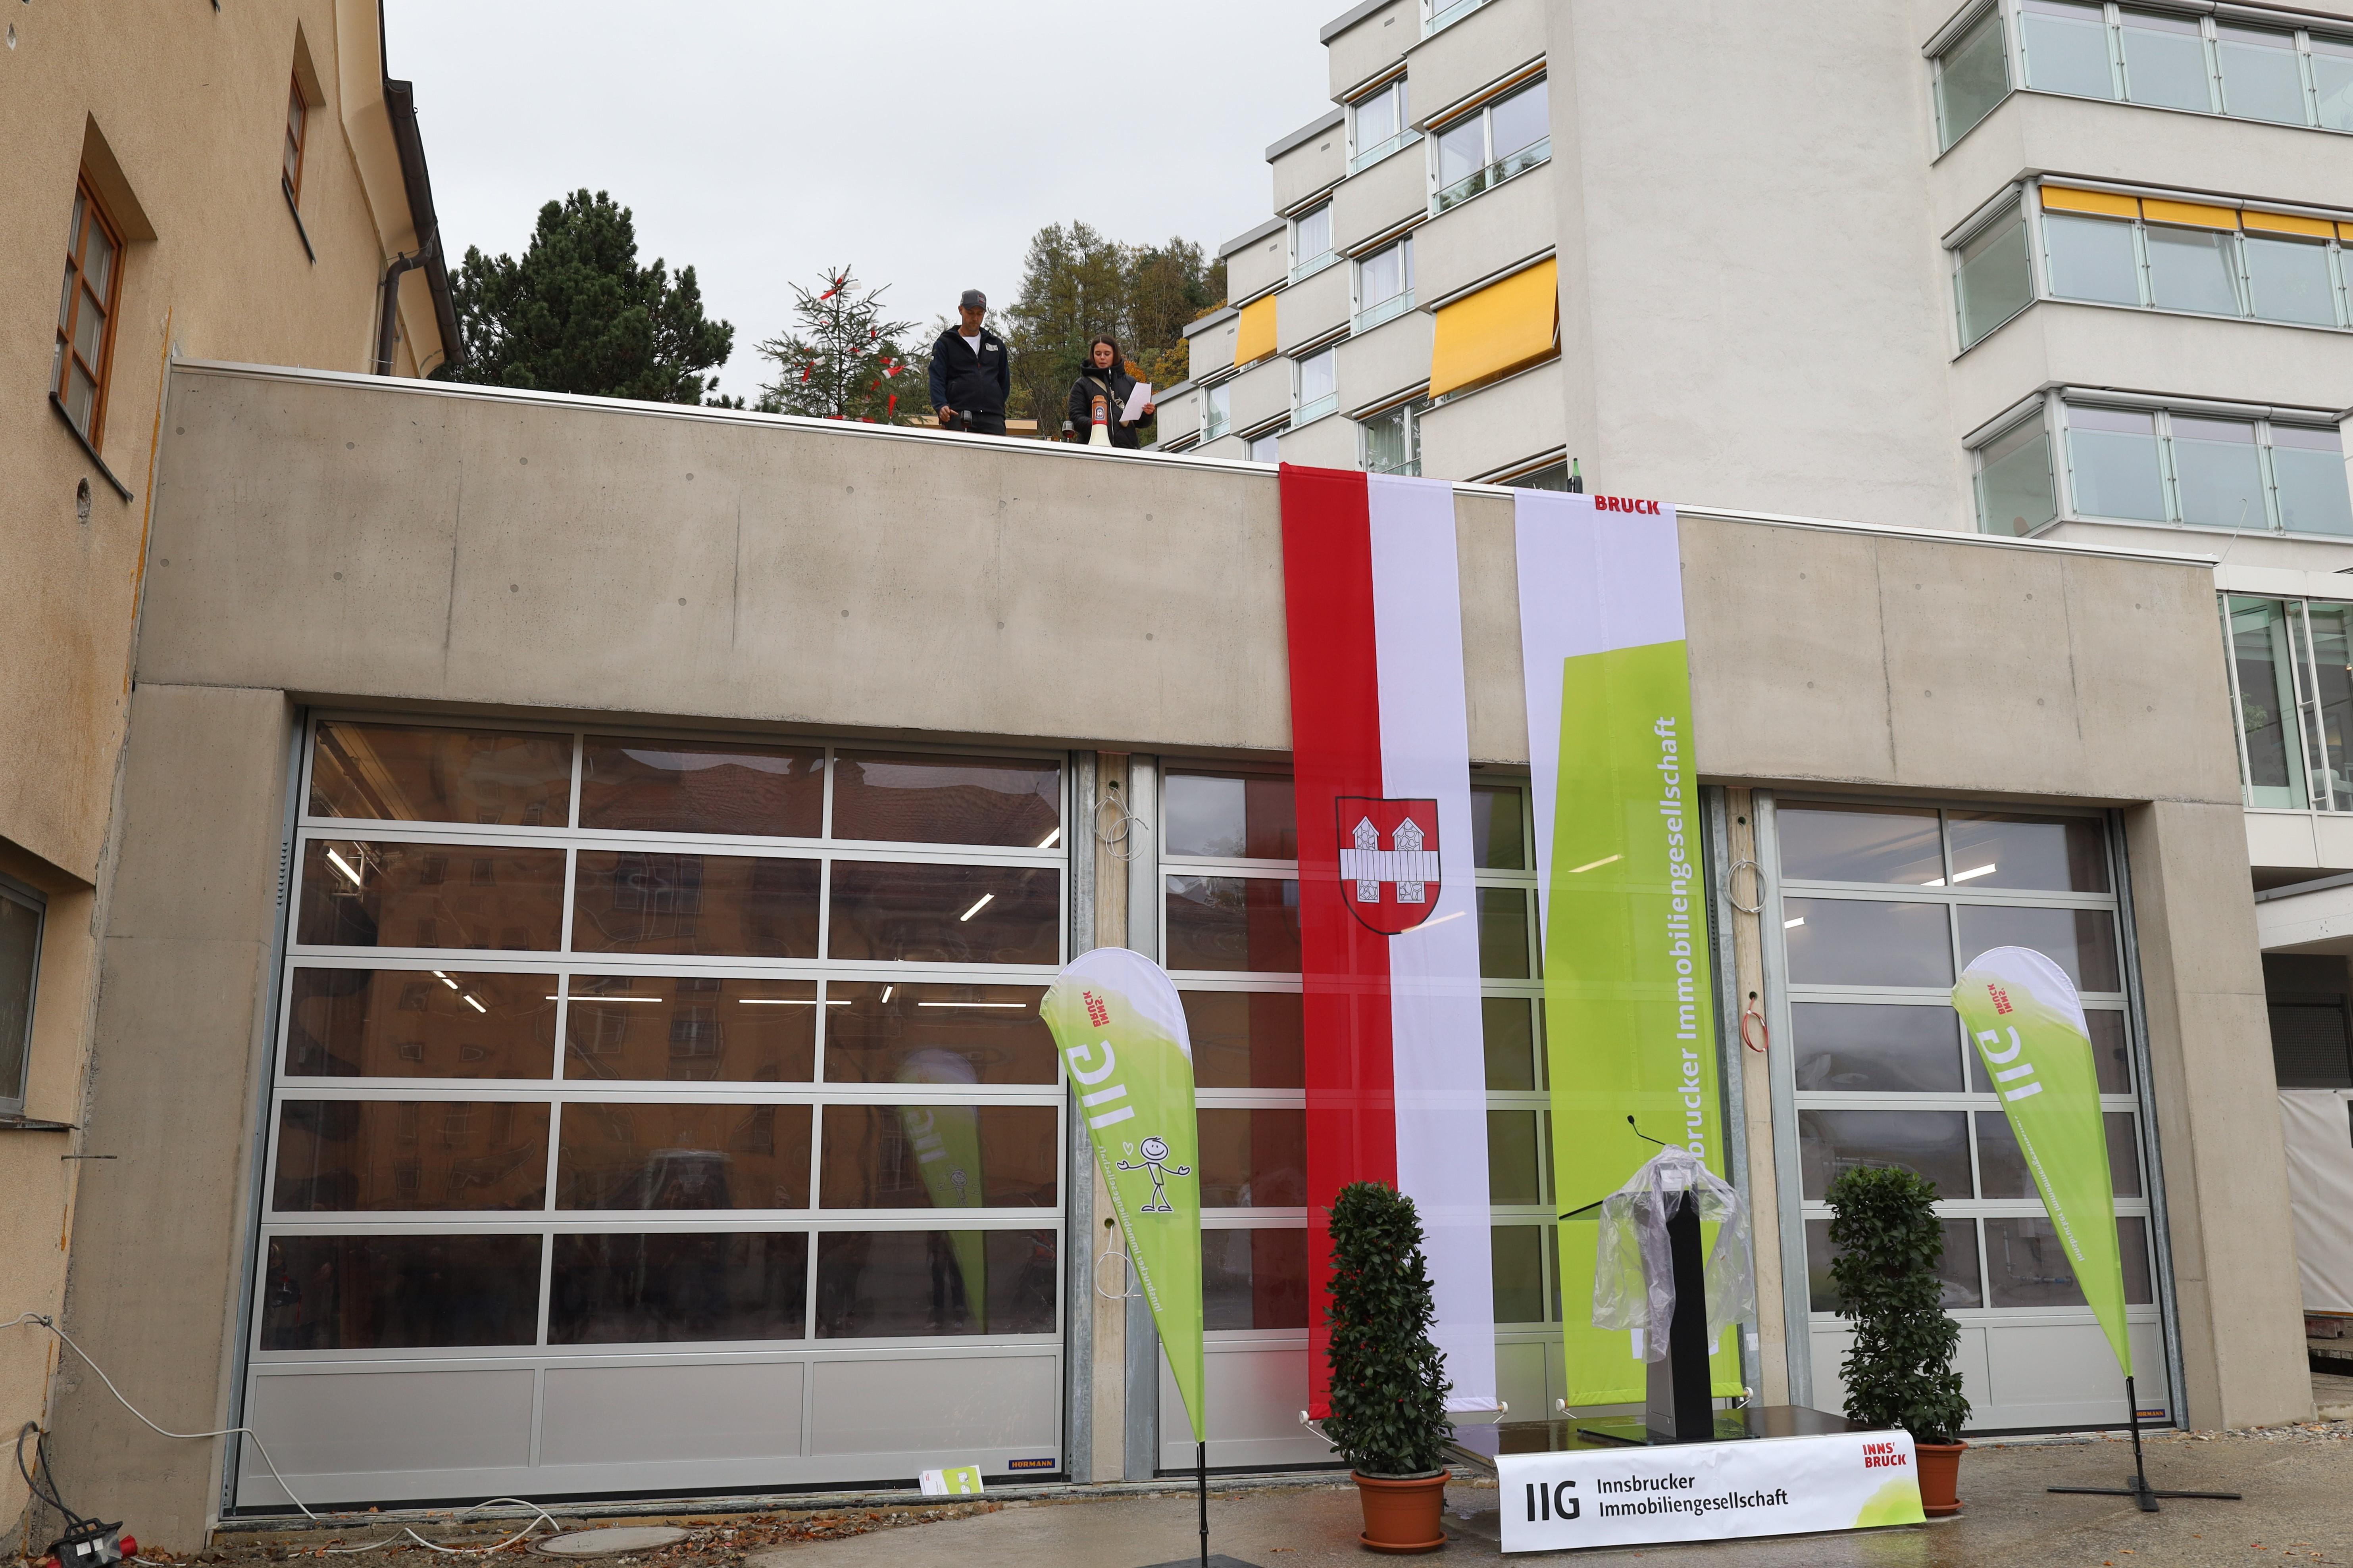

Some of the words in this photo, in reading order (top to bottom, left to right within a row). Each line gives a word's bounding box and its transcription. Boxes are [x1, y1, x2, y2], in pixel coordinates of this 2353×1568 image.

[1594, 495, 1660, 515] BRUCK
[1654, 716, 1697, 1039] Immobiliengesellschaft
[1862, 1442, 1895, 1456] INNS'
[1864, 1454, 1907, 1468] BRUCK
[1597, 1473, 1696, 1494] Innsbrucker
[1526, 1480, 1580, 1522] IIG
[1599, 1488, 1789, 1517] Immobiliengesellschaft
